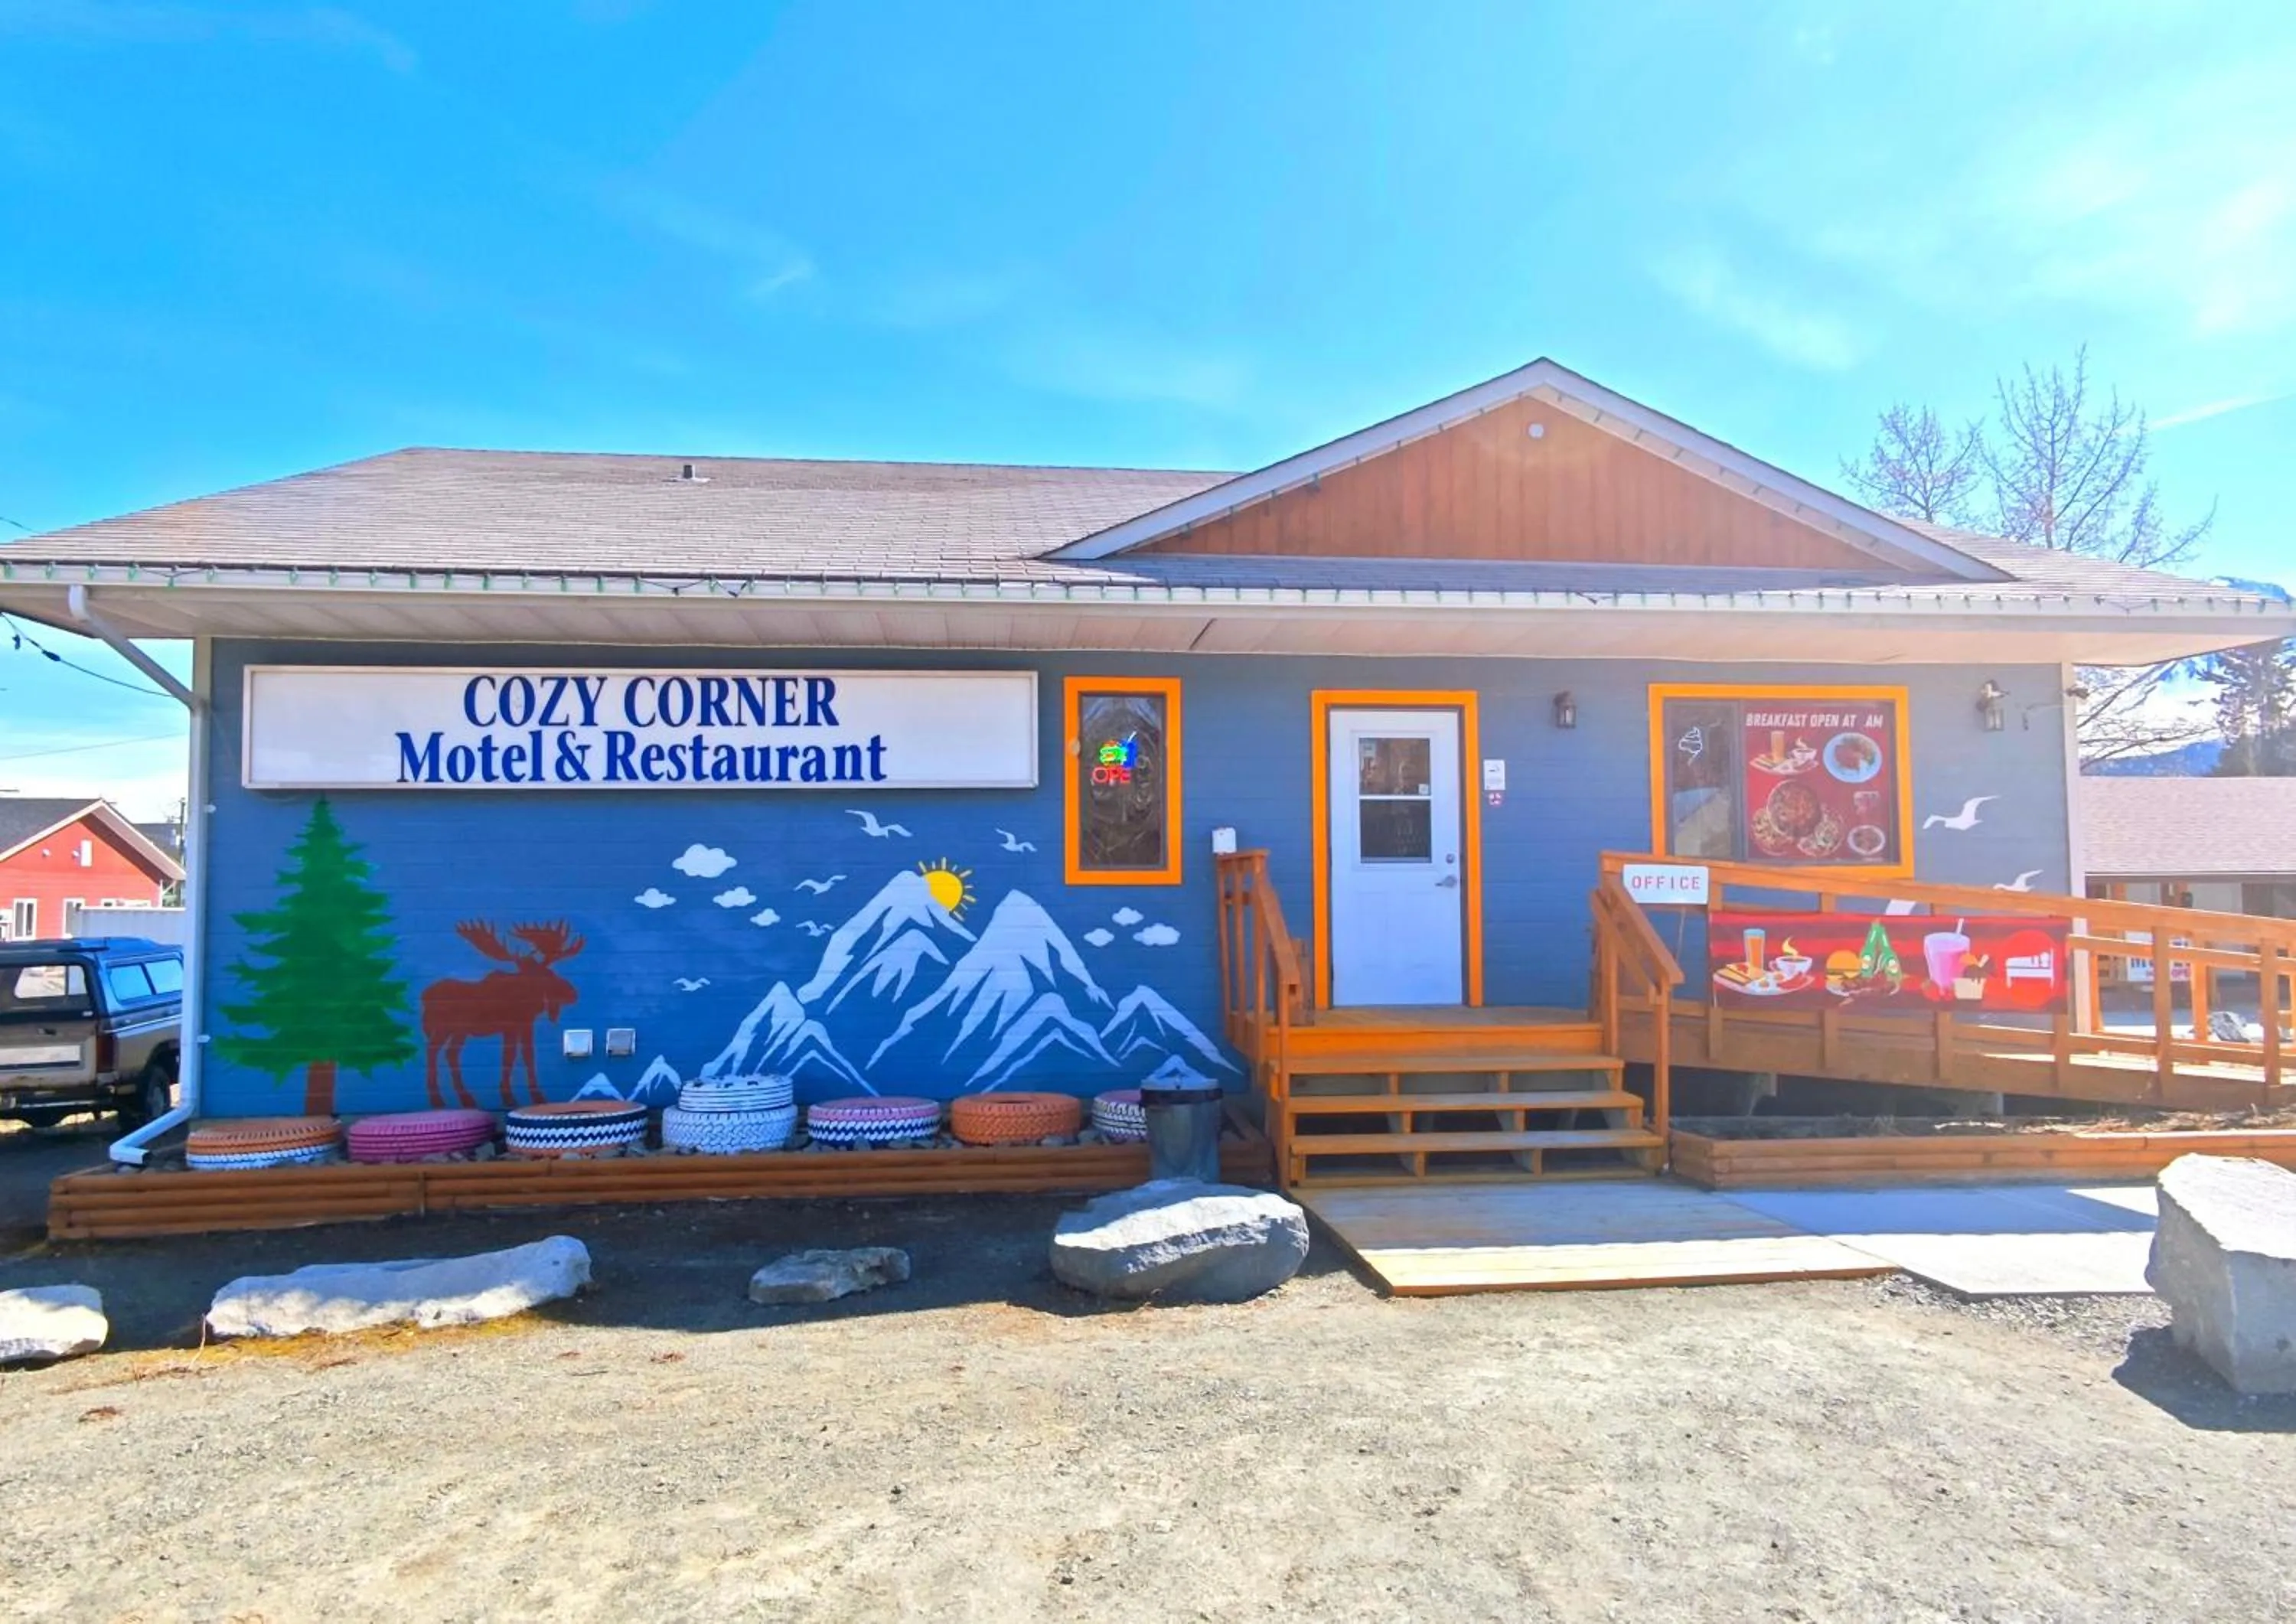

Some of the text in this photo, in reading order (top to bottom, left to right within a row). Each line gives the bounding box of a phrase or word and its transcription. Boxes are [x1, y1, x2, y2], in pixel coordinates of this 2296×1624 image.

[463, 675, 840, 727] COZY CORNER
[1746, 713, 1883, 728] BREAKFAST OPEN AT AM
[395, 729, 888, 783] Motel & Restaurant
[1632, 876, 1701, 889] OFFICE
